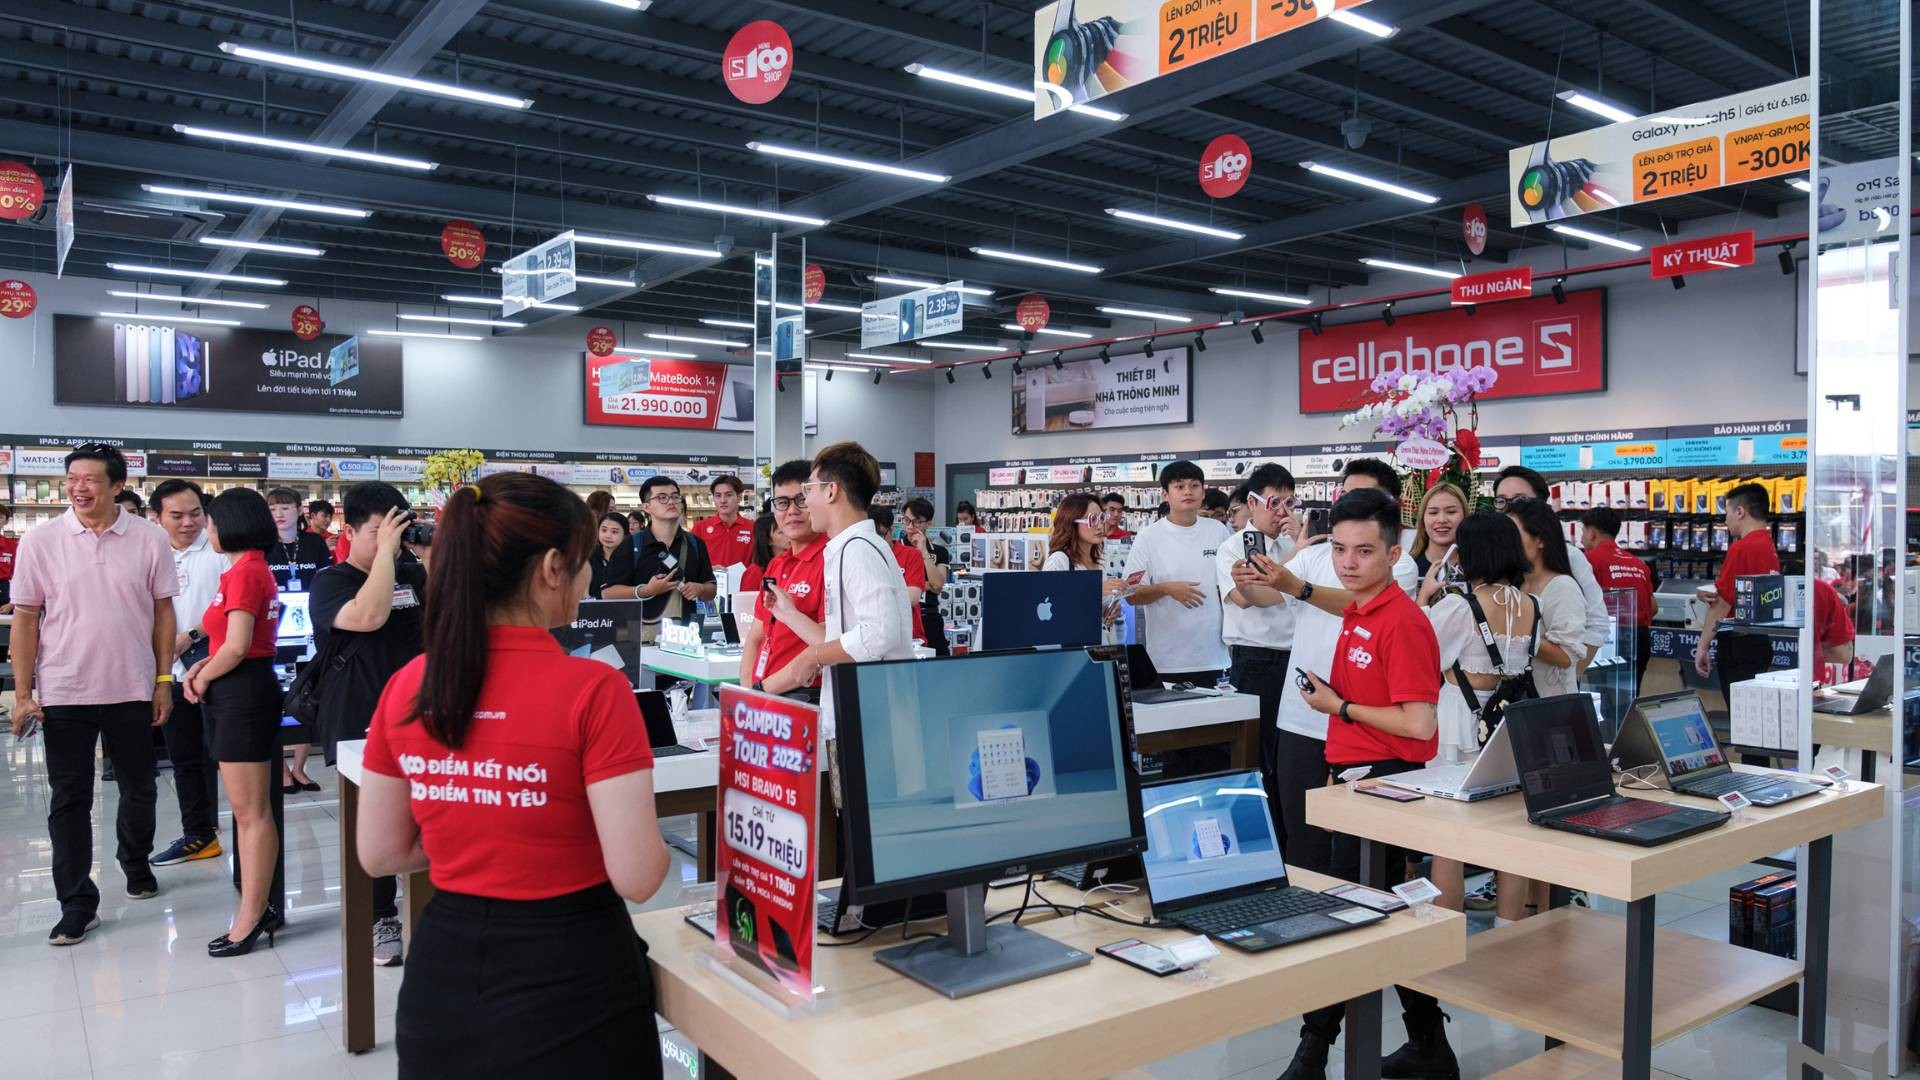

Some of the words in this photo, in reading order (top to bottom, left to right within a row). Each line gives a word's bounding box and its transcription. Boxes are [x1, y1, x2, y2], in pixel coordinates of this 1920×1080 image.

[1168, 28, 1185, 65] 2
[1187, 12, 1238, 49] TRIỆU
[747, 46, 788, 79] 100
[763, 71, 782, 83] SHOP
[1632, 123, 1680, 142] Galaxy
[1683, 107, 1736, 130] ch5
[1744, 102, 1764, 116] Giá
[1767, 99, 1779, 110] từ
[1638, 154, 1655, 167] LÊN
[1695, 142, 1714, 155] GIÁ
[1216, 153, 1247, 179] 100
[1642, 170, 1659, 196] 2
[1659, 162, 1708, 188] TRIỆU
[449, 246, 481, 263] 50%
[1662, 250, 1686, 268] KỸ
[1687, 242, 1740, 263] THUẬT
[1460, 284, 1483, 298] THU
[1486, 278, 1523, 296] NGÂN
[1, 299, 32, 312] 29K
[927, 297, 947, 315] 2.39
[297, 321, 318, 335] 29K
[1020, 316, 1047, 326] 50%
[592, 341, 613, 353] 29K
[280, 350, 322, 369] iPad
[650, 370, 702, 386] MateBook
[704, 375, 716, 387] 14
[1116, 366, 1141, 383] THIẾT
[1142, 368, 1157, 383] BỊ
[257, 384, 272, 393] Lên
[332, 387, 337, 396] 1
[337, 387, 357, 398] Triệu
[1095, 389, 1116, 403] NHÀ
[1117, 384, 1151, 401] THÔNG
[1152, 384, 1180, 398] MINH
[621, 397, 702, 415] 21.990.000
[1550, 435, 1566, 444] PHỤ
[1566, 433, 1585, 443] KIỆN
[1585, 431, 1610, 441] CHÍNH
[1611, 431, 1634, 440] HÃNG
[1713, 423, 1733, 435] BẢO
[1734, 423, 1760, 434] HÀNH
[1762, 424, 1766, 432] 1
[1786, 423, 1791, 431] 1
[193, 442, 222, 450] IPHONE
[286, 445, 303, 453] ĐIỆN
[304, 445, 325, 453] THOẠI
[22, 456, 56, 464] WATCH
[380, 463, 403, 471] Redmi
[404, 464, 418, 472] Pad
[1623, 456, 1663, 466] 3.790.000
[579, 618, 600, 629] iPad
[601, 618, 614, 628] Air
[734, 700, 793, 741] CAMPUS
[733, 732, 769, 769] TOUR
[771, 744, 803, 773] 2022
[427, 752, 468, 776] ĐIỂM
[473, 757, 502, 779] KẾT
[506, 762, 548, 784] NỐI
[428, 778, 468, 803] ĐIỂM
[472, 791, 502, 806] TIN
[506, 788, 548, 808] YÊU
[734, 769, 750, 788] MSI
[751, 776, 783, 801] BRAVO
[785, 787, 797, 807] 15
[727, 810, 765, 851] 15.19
[767, 836, 803, 871] TRIỆU
